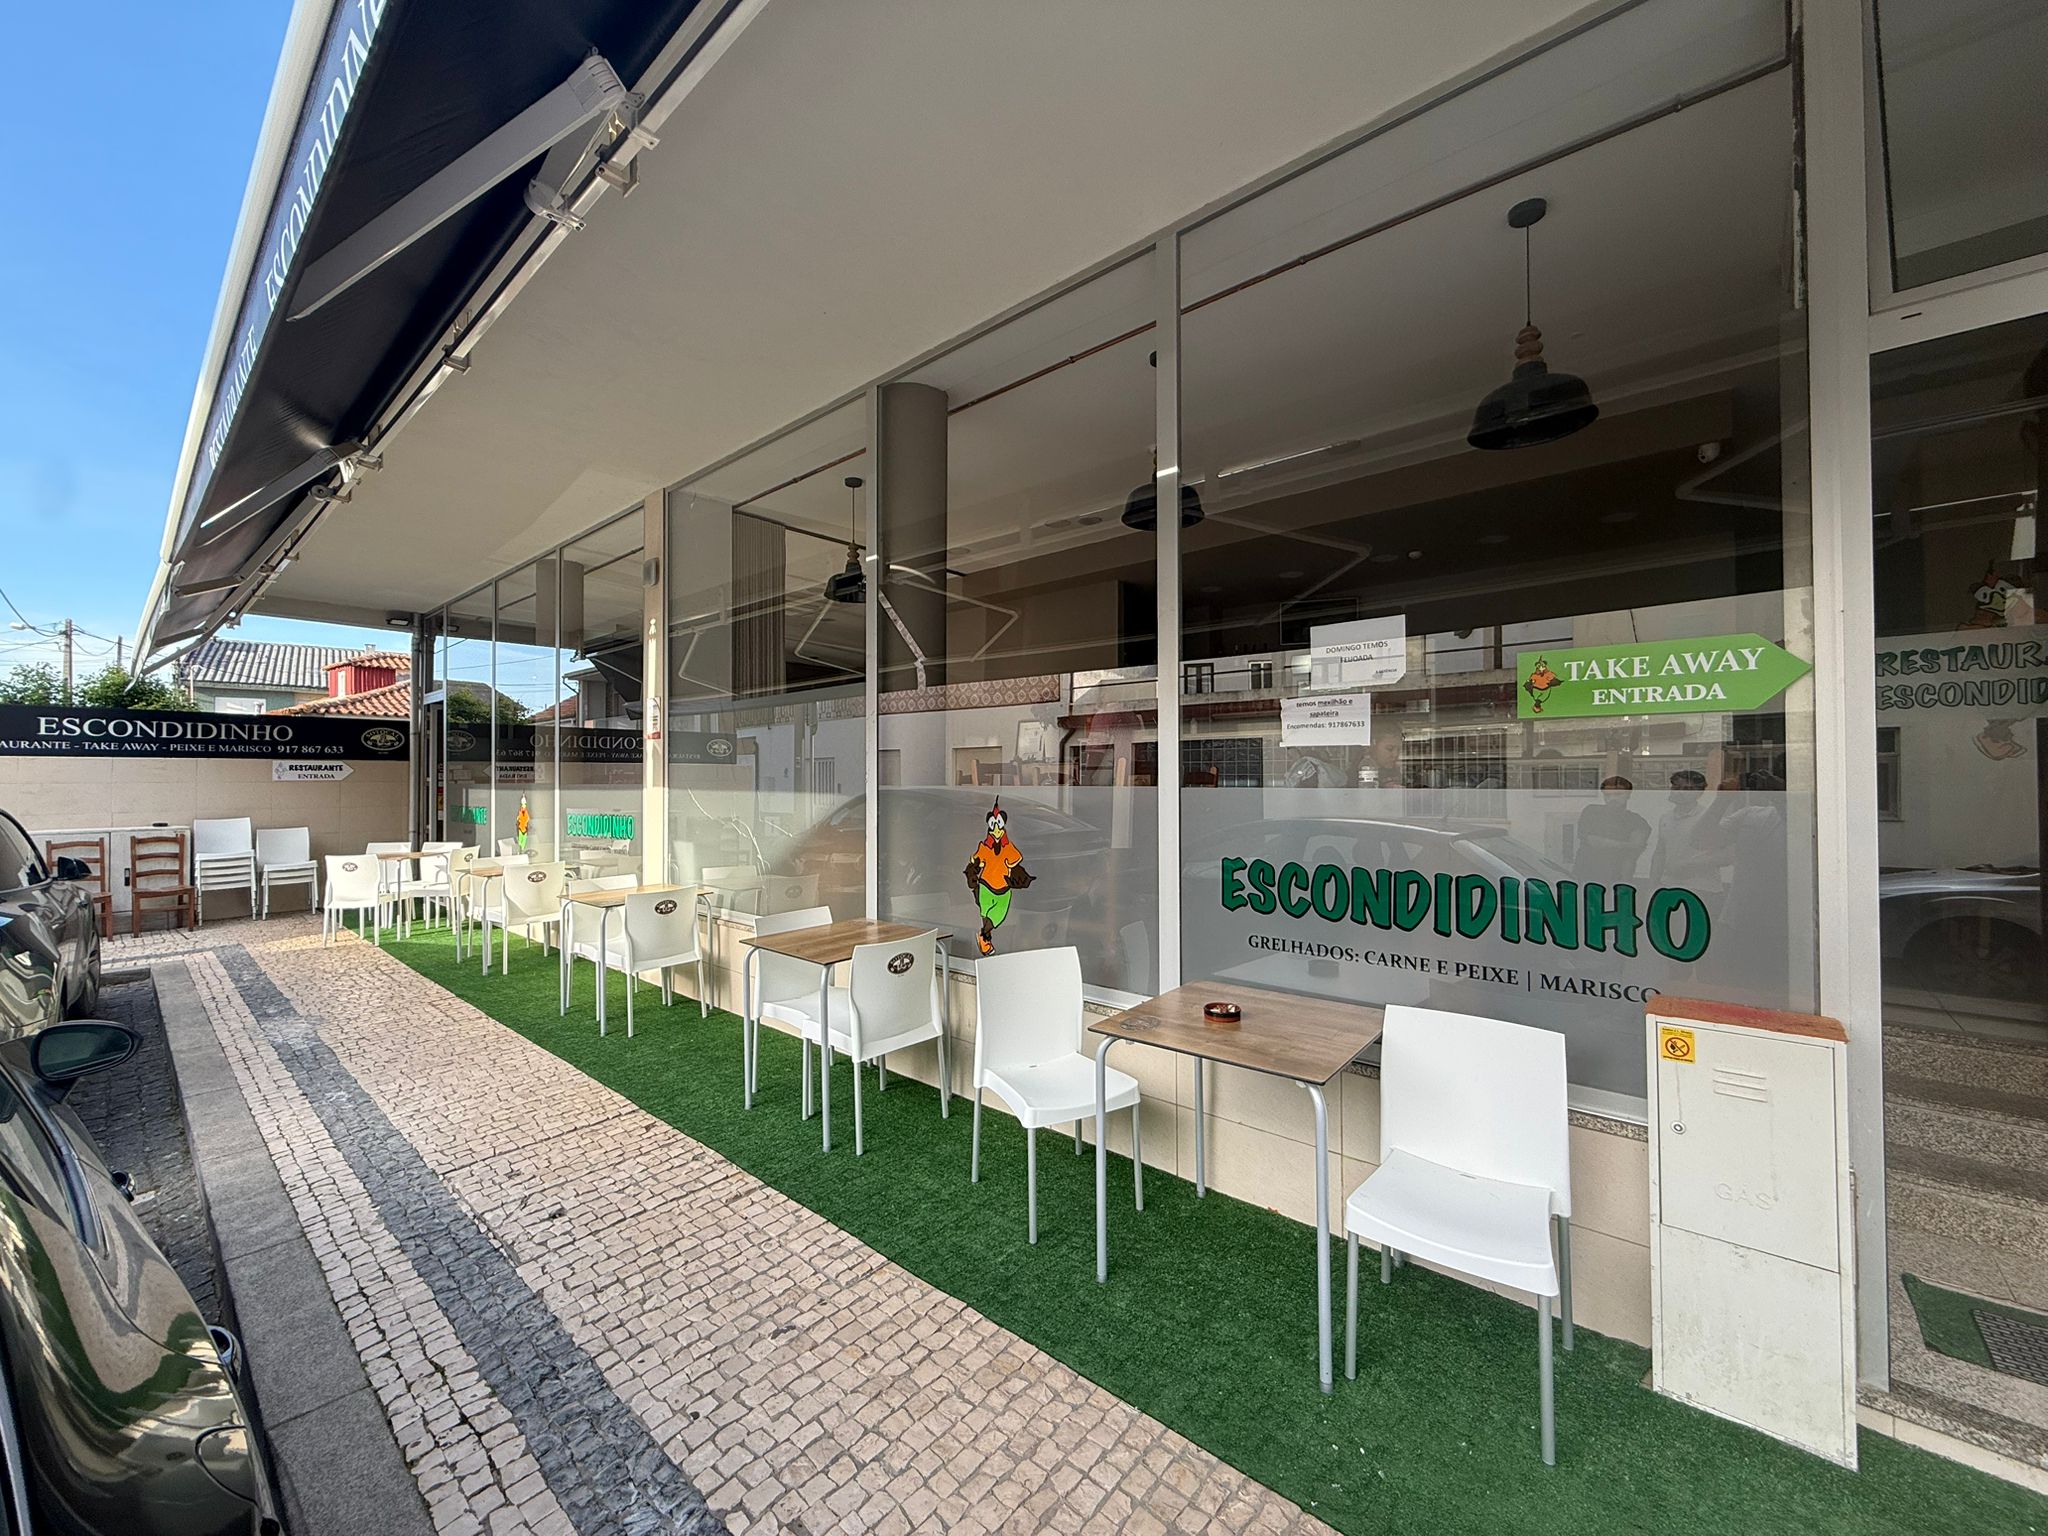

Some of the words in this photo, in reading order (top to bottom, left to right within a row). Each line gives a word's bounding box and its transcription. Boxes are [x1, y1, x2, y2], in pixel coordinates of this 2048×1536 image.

[1325, 644, 1362, 654] DOMINGO
[1363, 640, 1389, 650] TEMOS
[1875, 640, 2048, 677] RESTAUR
[1564, 655, 1651, 683] TAKE
[1660, 647, 1766, 676] AWAY
[1591, 682, 1728, 706] ENTRADA
[36, 716, 294, 742] ESCONDIDINHO
[1286, 722, 1327, 730] Encomendas:
[1328, 720, 1365, 728] 917867633
[82, 741, 119, 750] TAKE
[122, 742, 159, 751] AWAY
[170, 743, 206, 752] PEIXE
[208, 744, 216, 752] E
[218, 744, 272, 753] MARISCO
[277, 745, 299, 754] 917
[301, 745, 322, 754] 867
[324, 745, 344, 754] 633
[288, 763, 344, 772] RESTAURANTE
[567, 812, 635, 841] ESCONDIDINHO
[1220, 856, 1712, 963] ESCONDIDINHO
[1248, 934, 1360, 963] GRELHADOS:
[1363, 949, 1431, 974] CARNE
[1437, 959, 1449, 976] E
[1455, 961, 1519, 985] PEIXE
[1713, 1182, 1774, 1211] GAS
